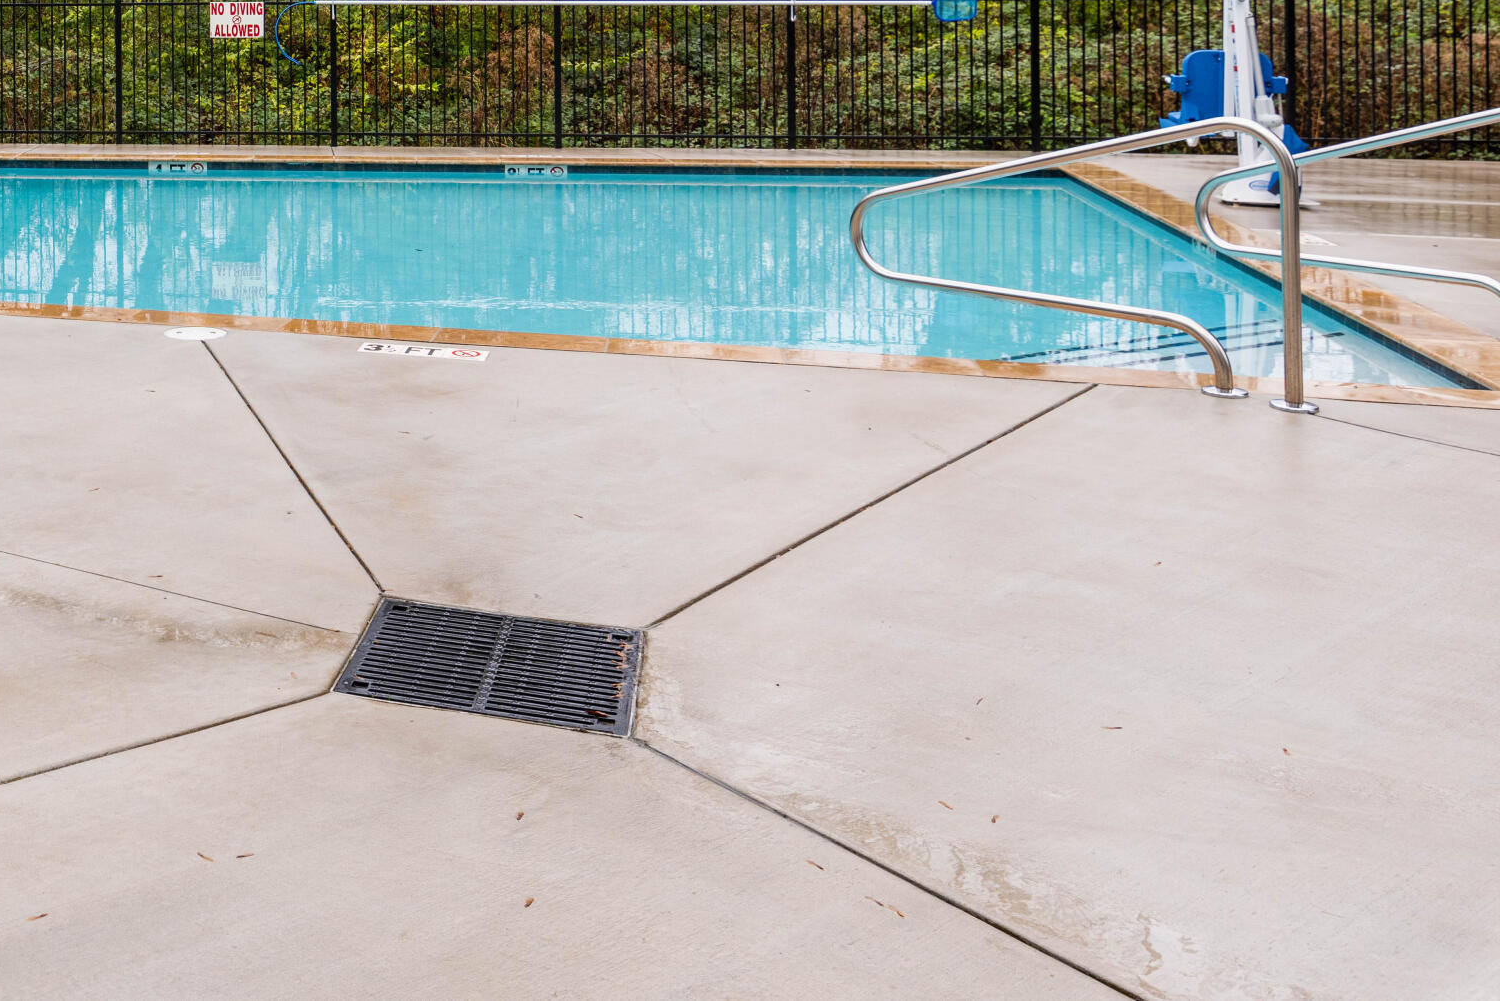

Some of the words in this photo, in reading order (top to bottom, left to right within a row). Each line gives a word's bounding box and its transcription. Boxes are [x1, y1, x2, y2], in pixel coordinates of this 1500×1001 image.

[211, 2, 225, 16] NO
[230, 2, 263, 16] DIVING
[214, 23, 260, 37] ALLOWED
[404, 346, 442, 356] FT
